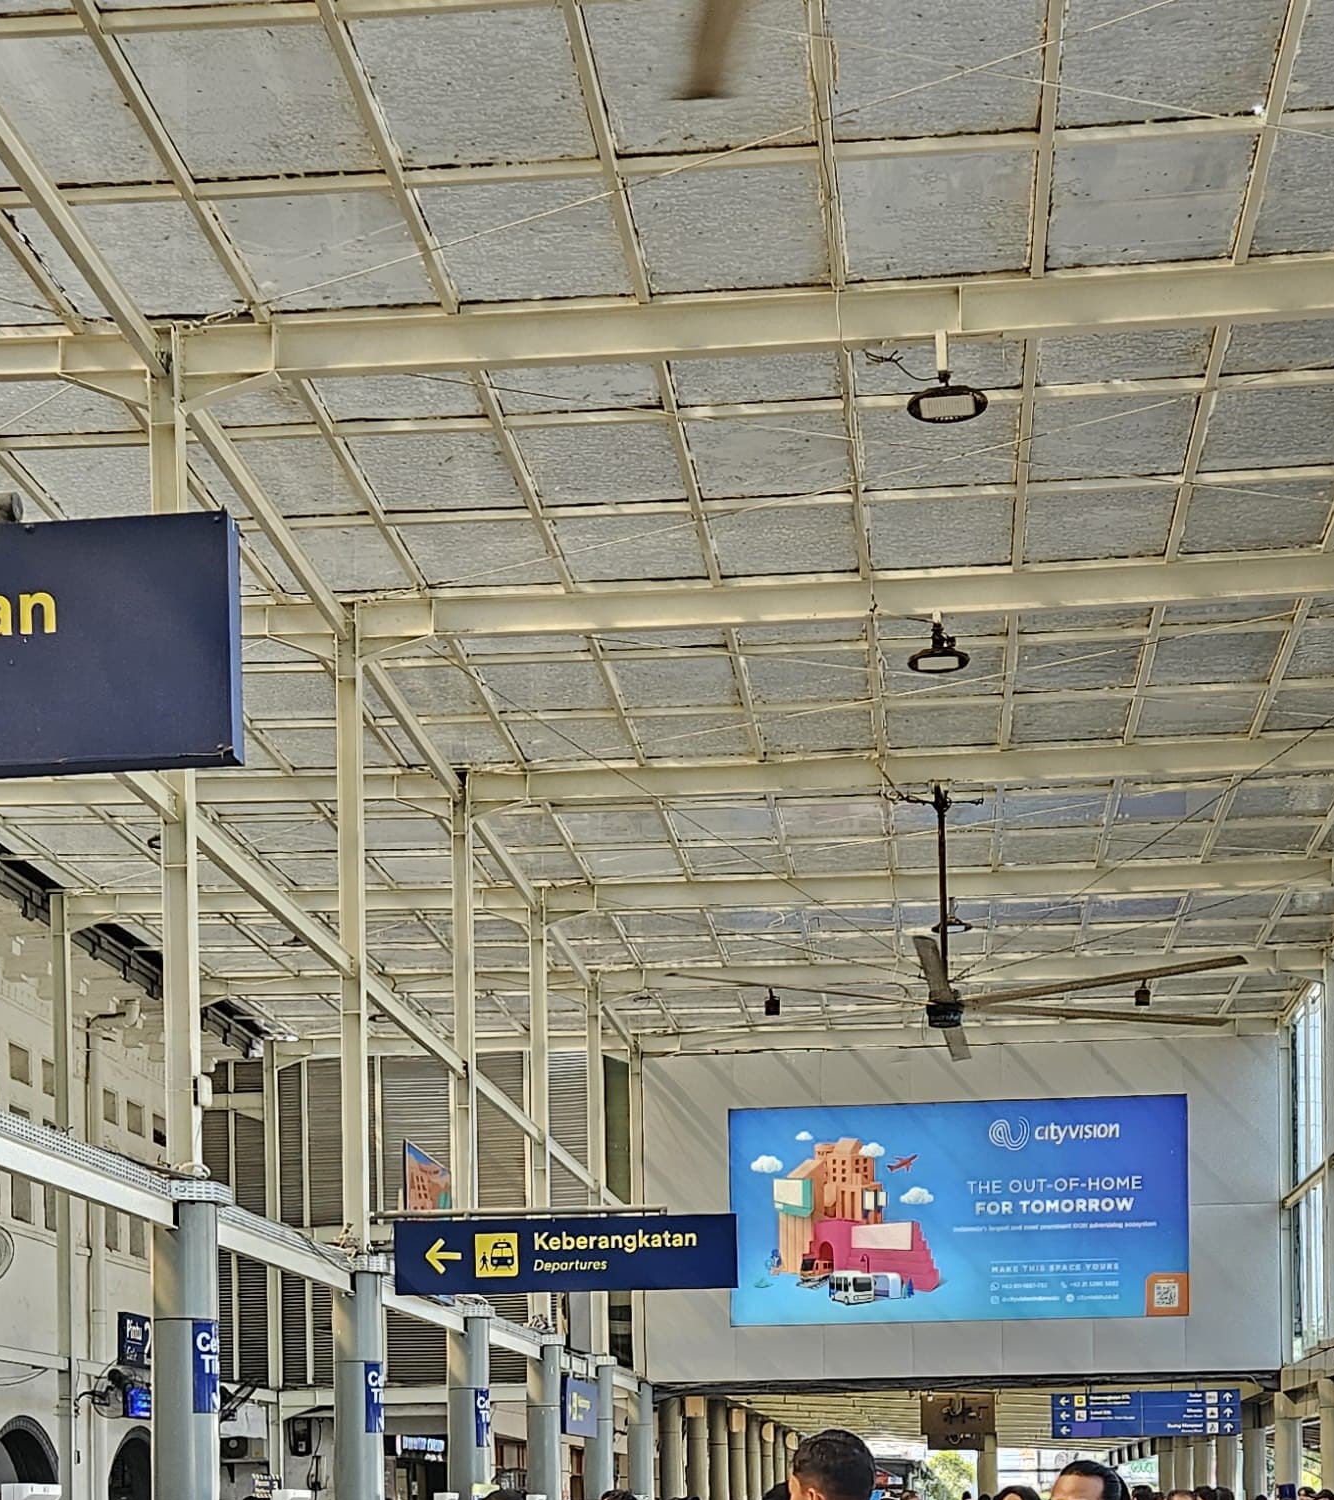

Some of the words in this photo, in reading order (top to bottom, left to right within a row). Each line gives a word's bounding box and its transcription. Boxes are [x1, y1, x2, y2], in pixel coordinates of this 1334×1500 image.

[1035, 1122, 1120, 1144] cityvision
[967, 1180, 1002, 1195] THE
[1009, 1175, 1143, 1194] OUT-OF-HOME
[975, 1201, 1013, 1215] FOR
[1019, 1197, 1135, 1214] TOMORROW
[533, 1229, 697, 1253] Keberangkatan
[533, 1259, 607, 1274] Departures
[991, 1264, 1019, 1273] MAKE
[1022, 1264, 1045, 1272] THIS
[1049, 1263, 1081, 1272] SPACE
[1085, 1262, 1119, 1271] YOURS
